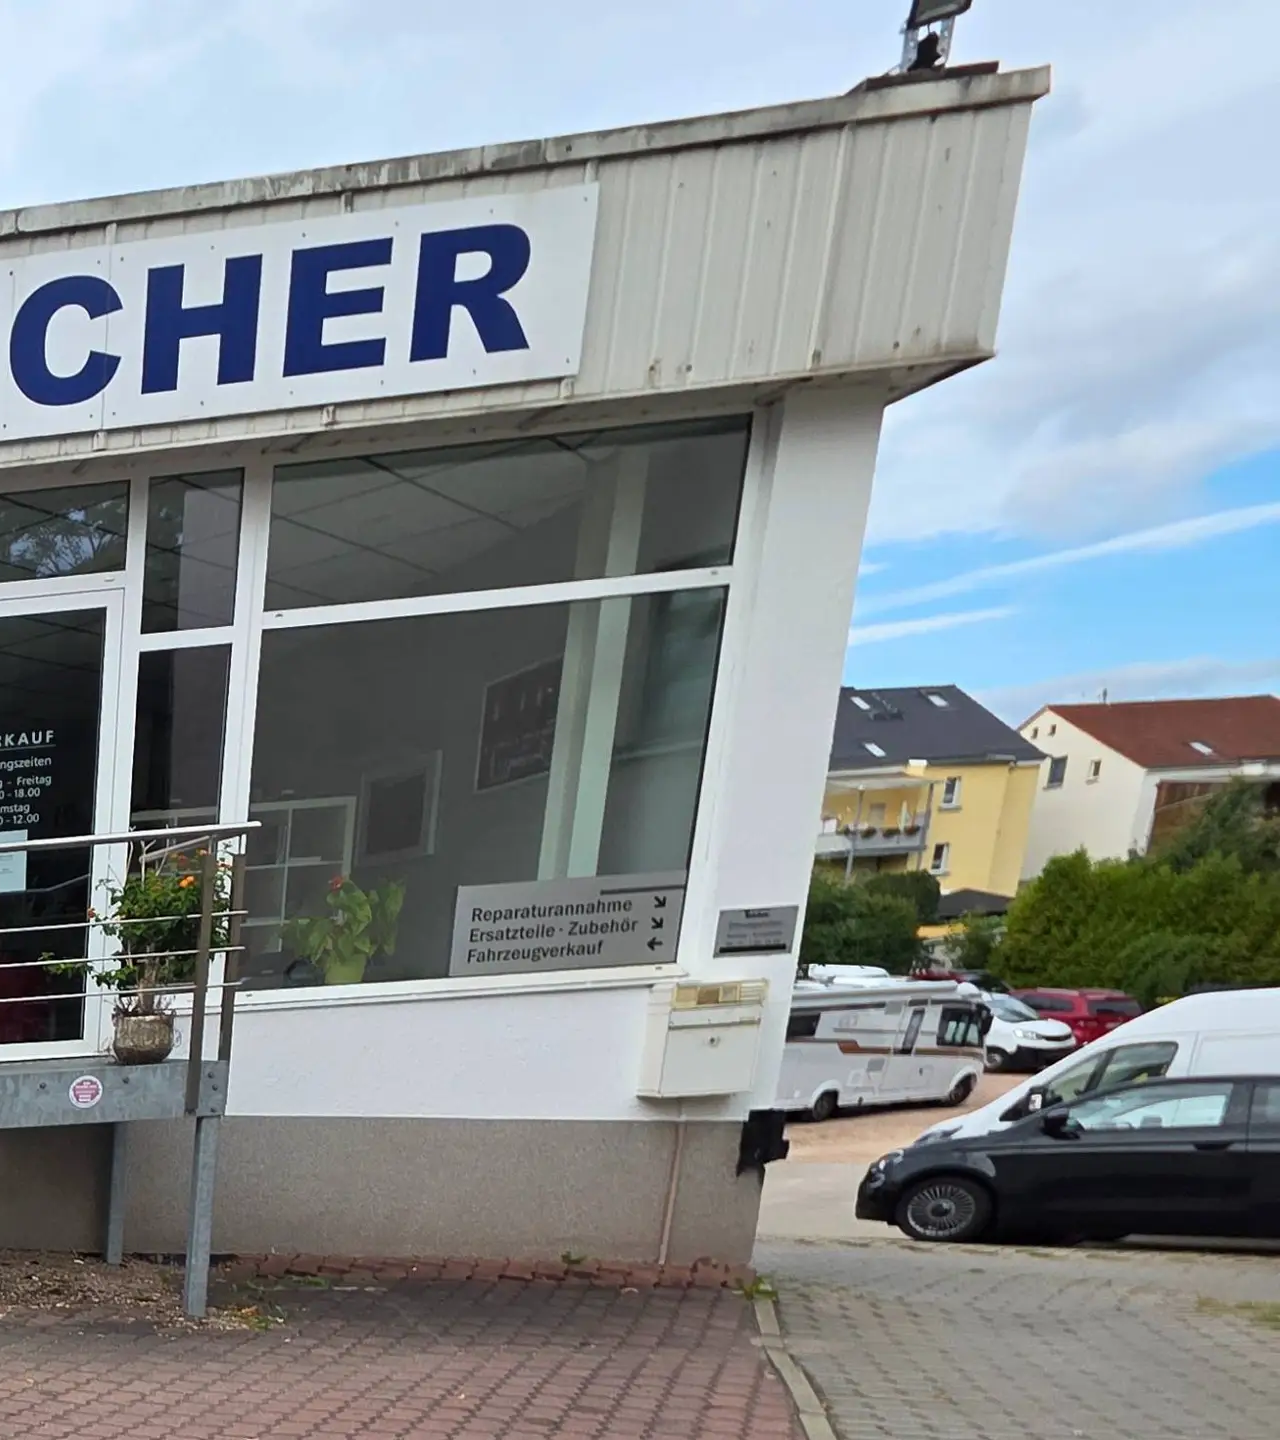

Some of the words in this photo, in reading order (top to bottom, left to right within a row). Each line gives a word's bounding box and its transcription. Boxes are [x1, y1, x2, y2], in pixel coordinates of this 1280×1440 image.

[16, 775, 52, 786] Freitag
[14, 787, 41, 798] 18.00
[12, 813, 40, 825] 12.00
[471, 899, 633, 924] Reparaturannahme
[469, 924, 555, 943] Ersatzteile
[567, 917, 638, 936] Zubehör
[467, 939, 603, 963] Fahrzeugverkauf
